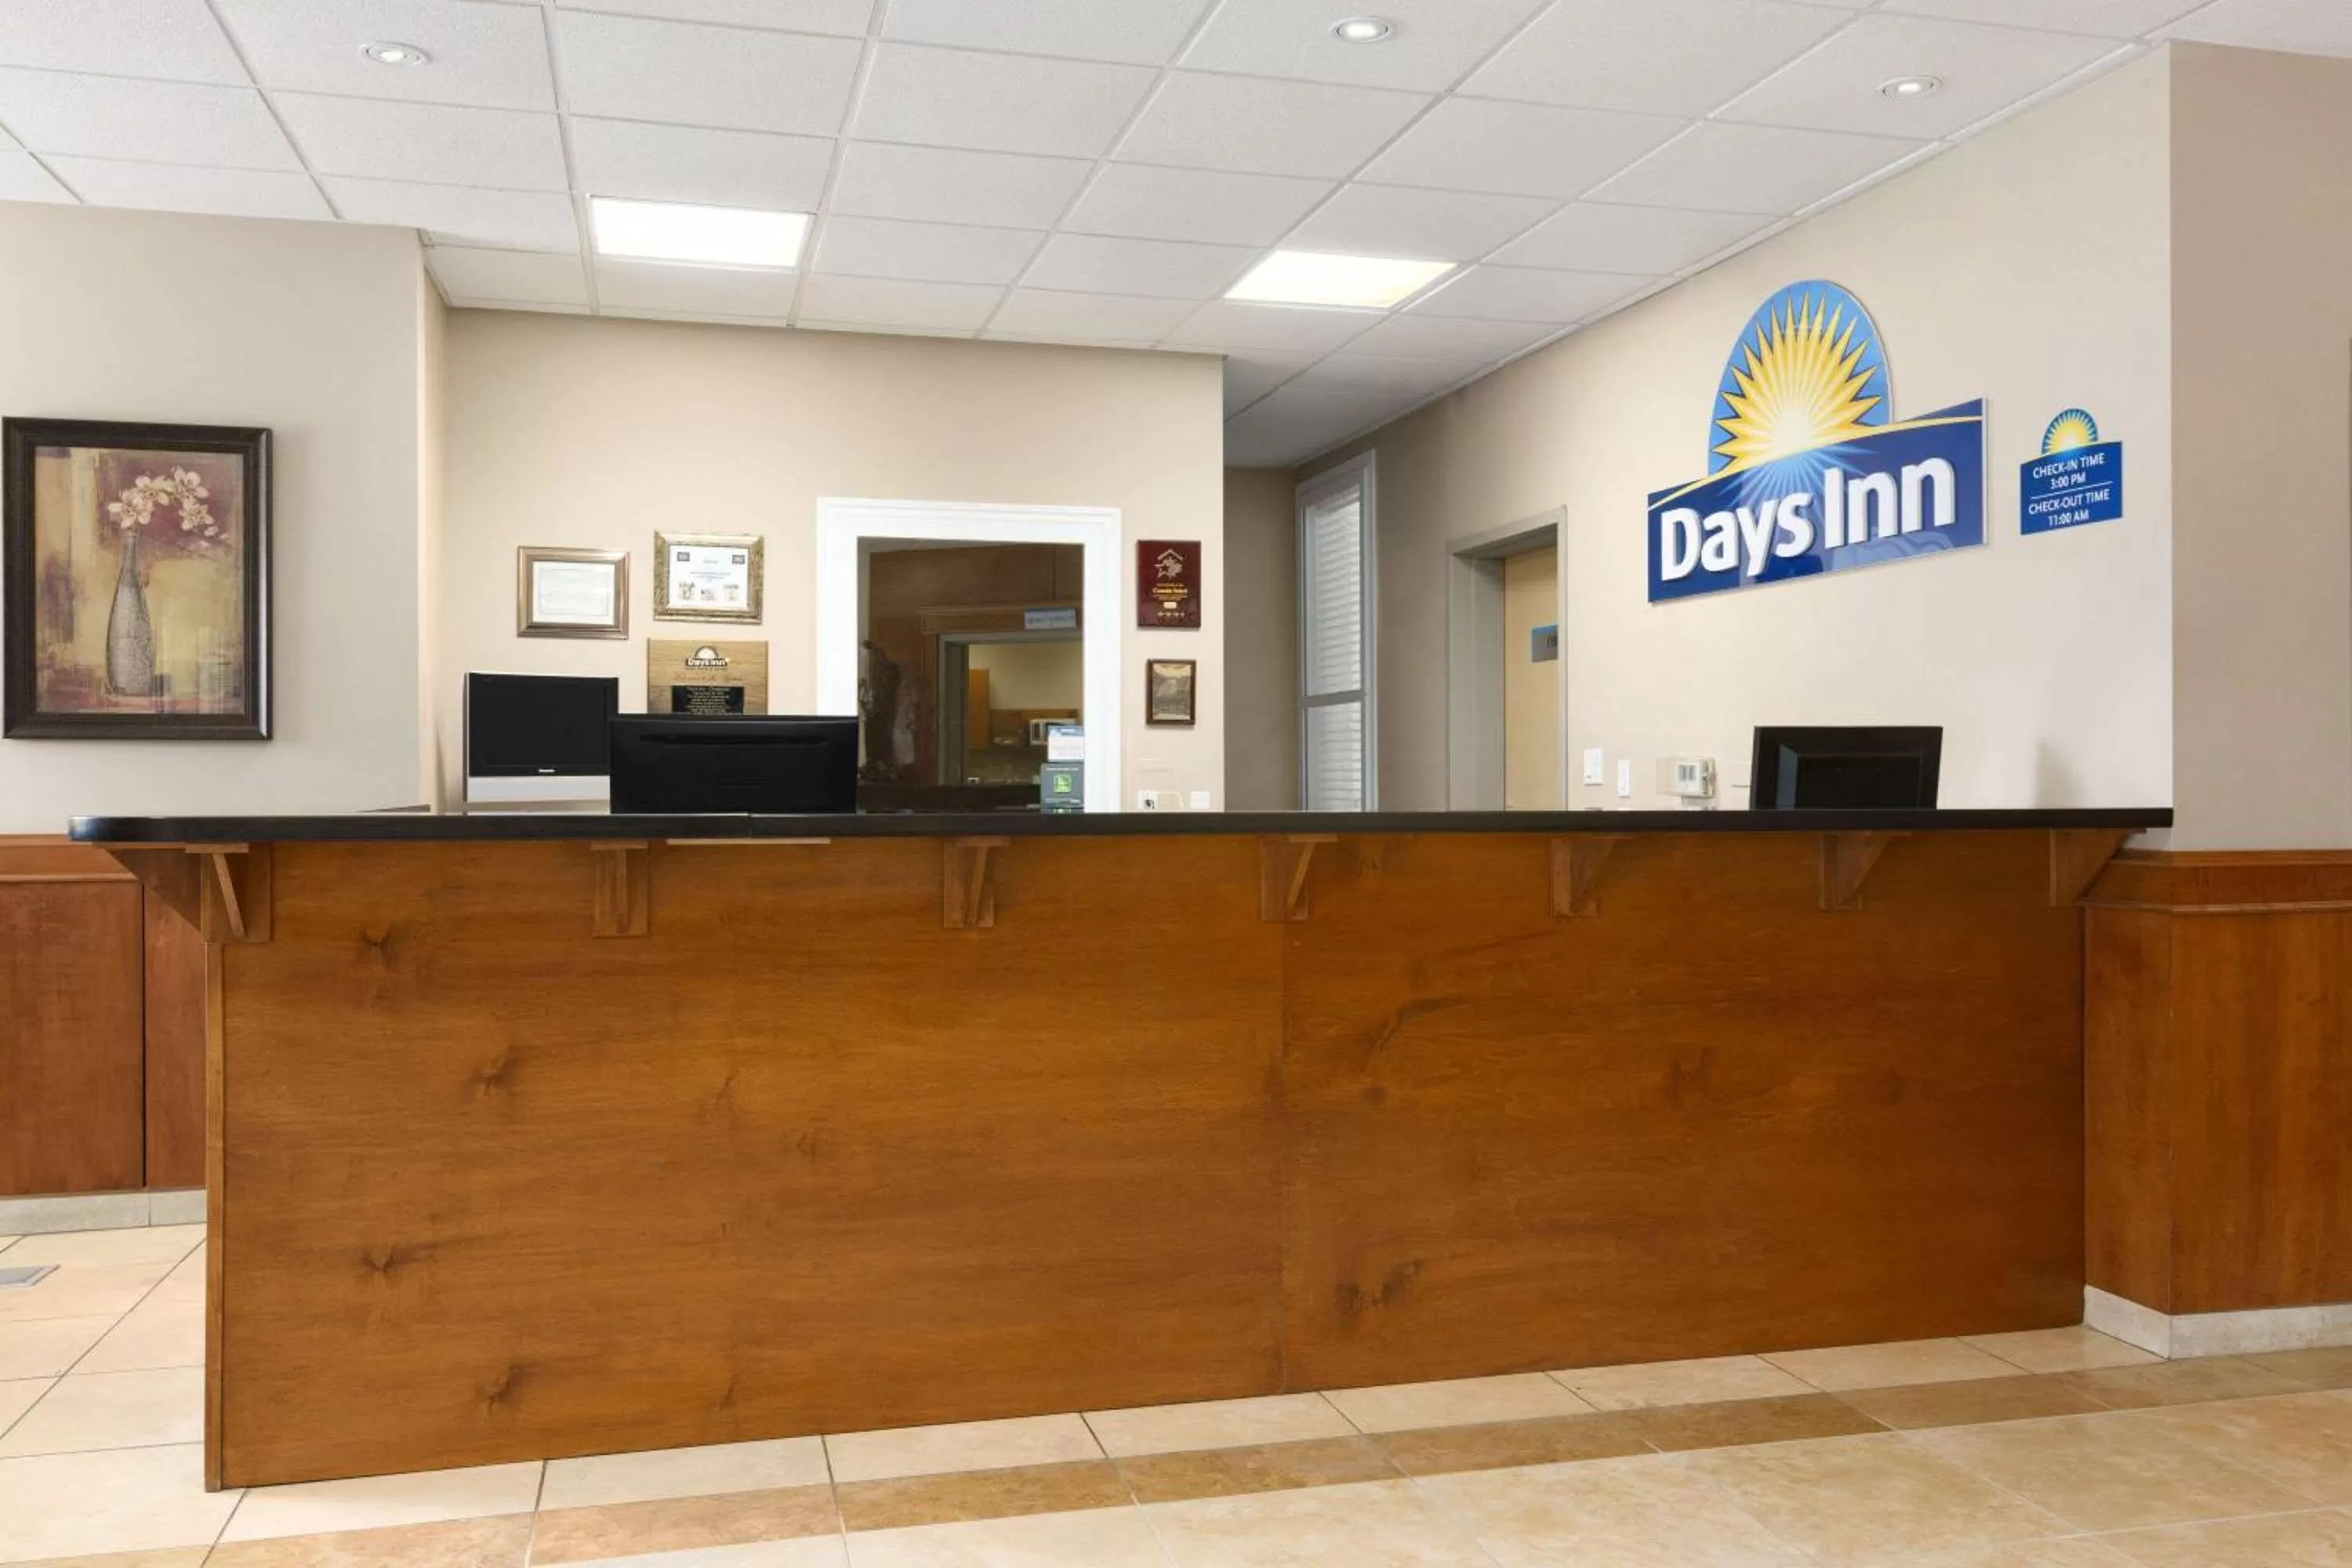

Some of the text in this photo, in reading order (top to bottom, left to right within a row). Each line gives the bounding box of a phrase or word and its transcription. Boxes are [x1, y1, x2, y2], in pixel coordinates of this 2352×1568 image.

[2033, 452, 2105, 479] CHECK-IN TIME
[2050, 472, 2086, 490] 3:00 PM
[2028, 488, 2110, 515] CHECK-OUT TIME
[1661, 457, 1956, 581] Days Inn
[2048, 509, 2089, 526] 11:00 AM
